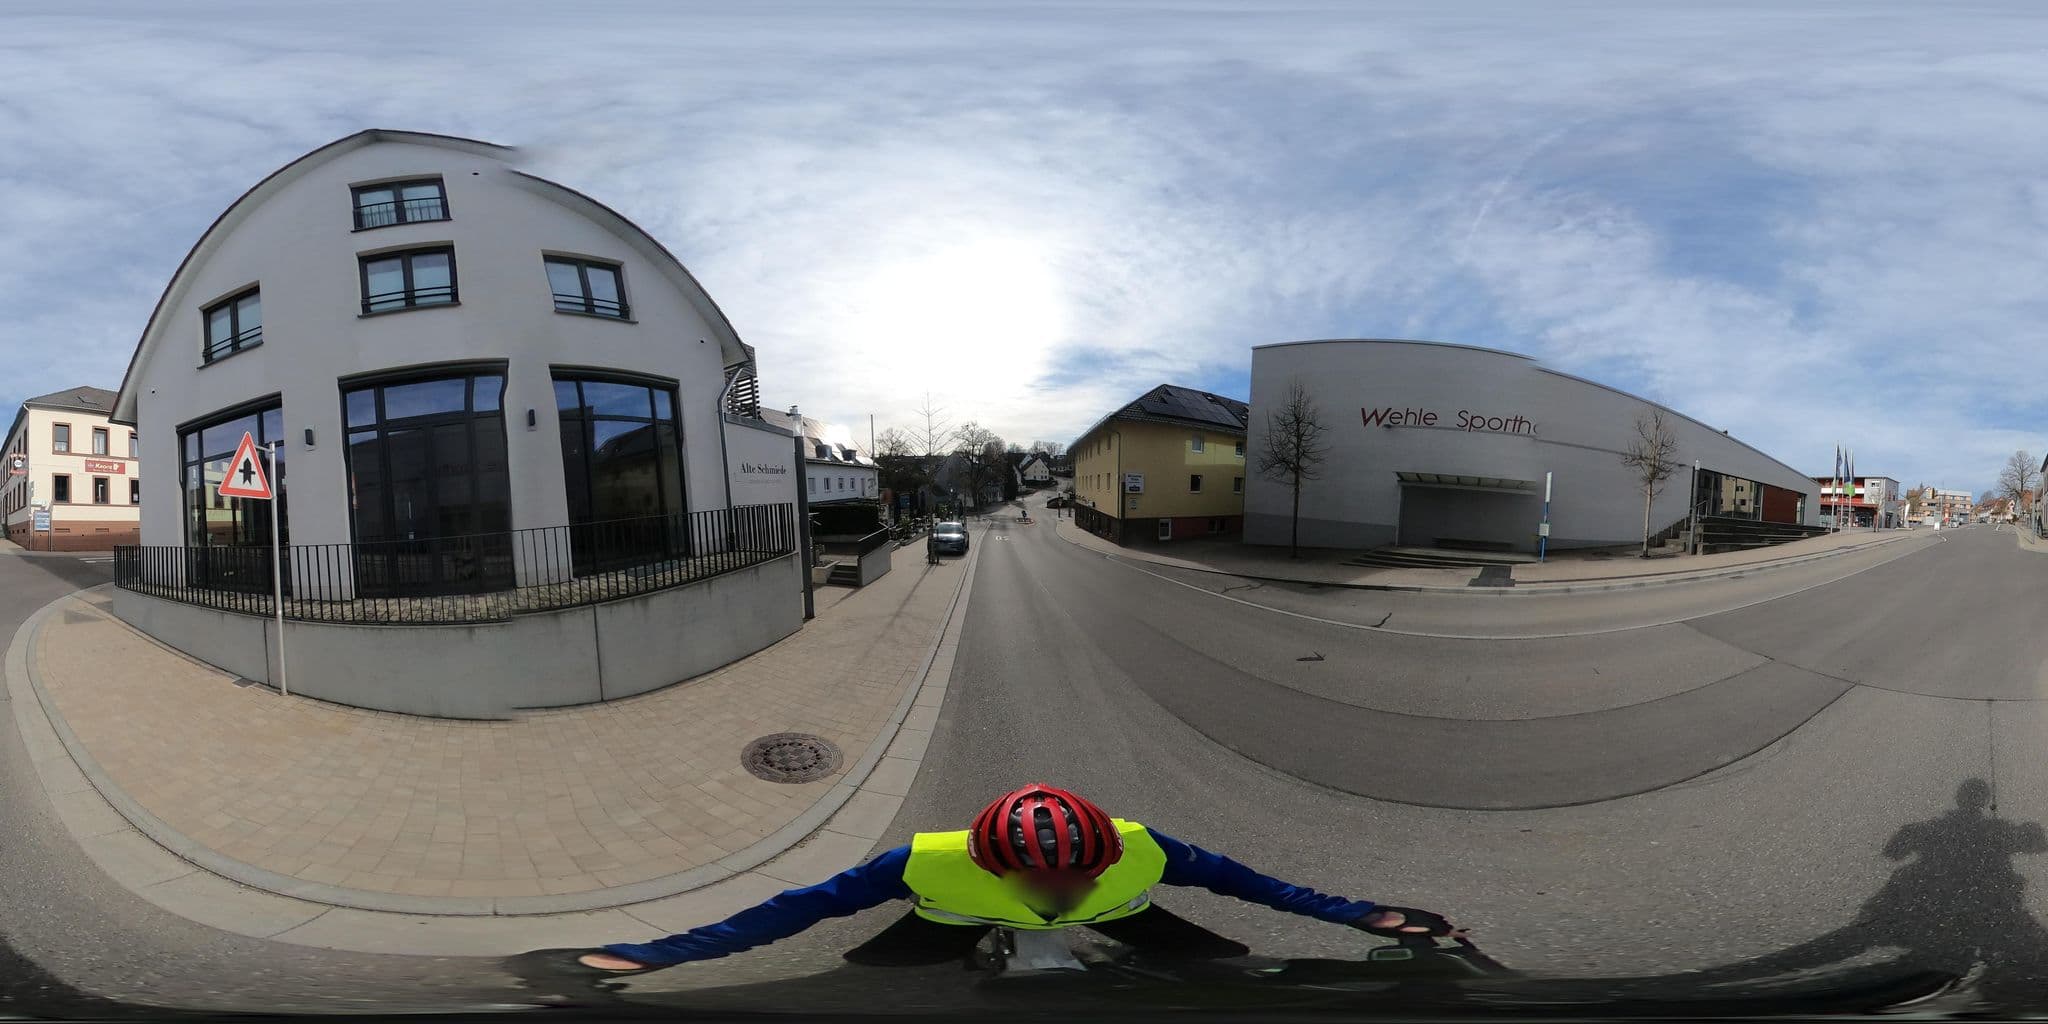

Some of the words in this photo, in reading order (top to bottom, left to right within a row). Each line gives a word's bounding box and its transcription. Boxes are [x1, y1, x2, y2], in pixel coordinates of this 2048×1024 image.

[1361, 408, 1438, 427] Wehle
[741, 463, 756, 473] Alte
[757, 464, 786, 475] Schmiede
